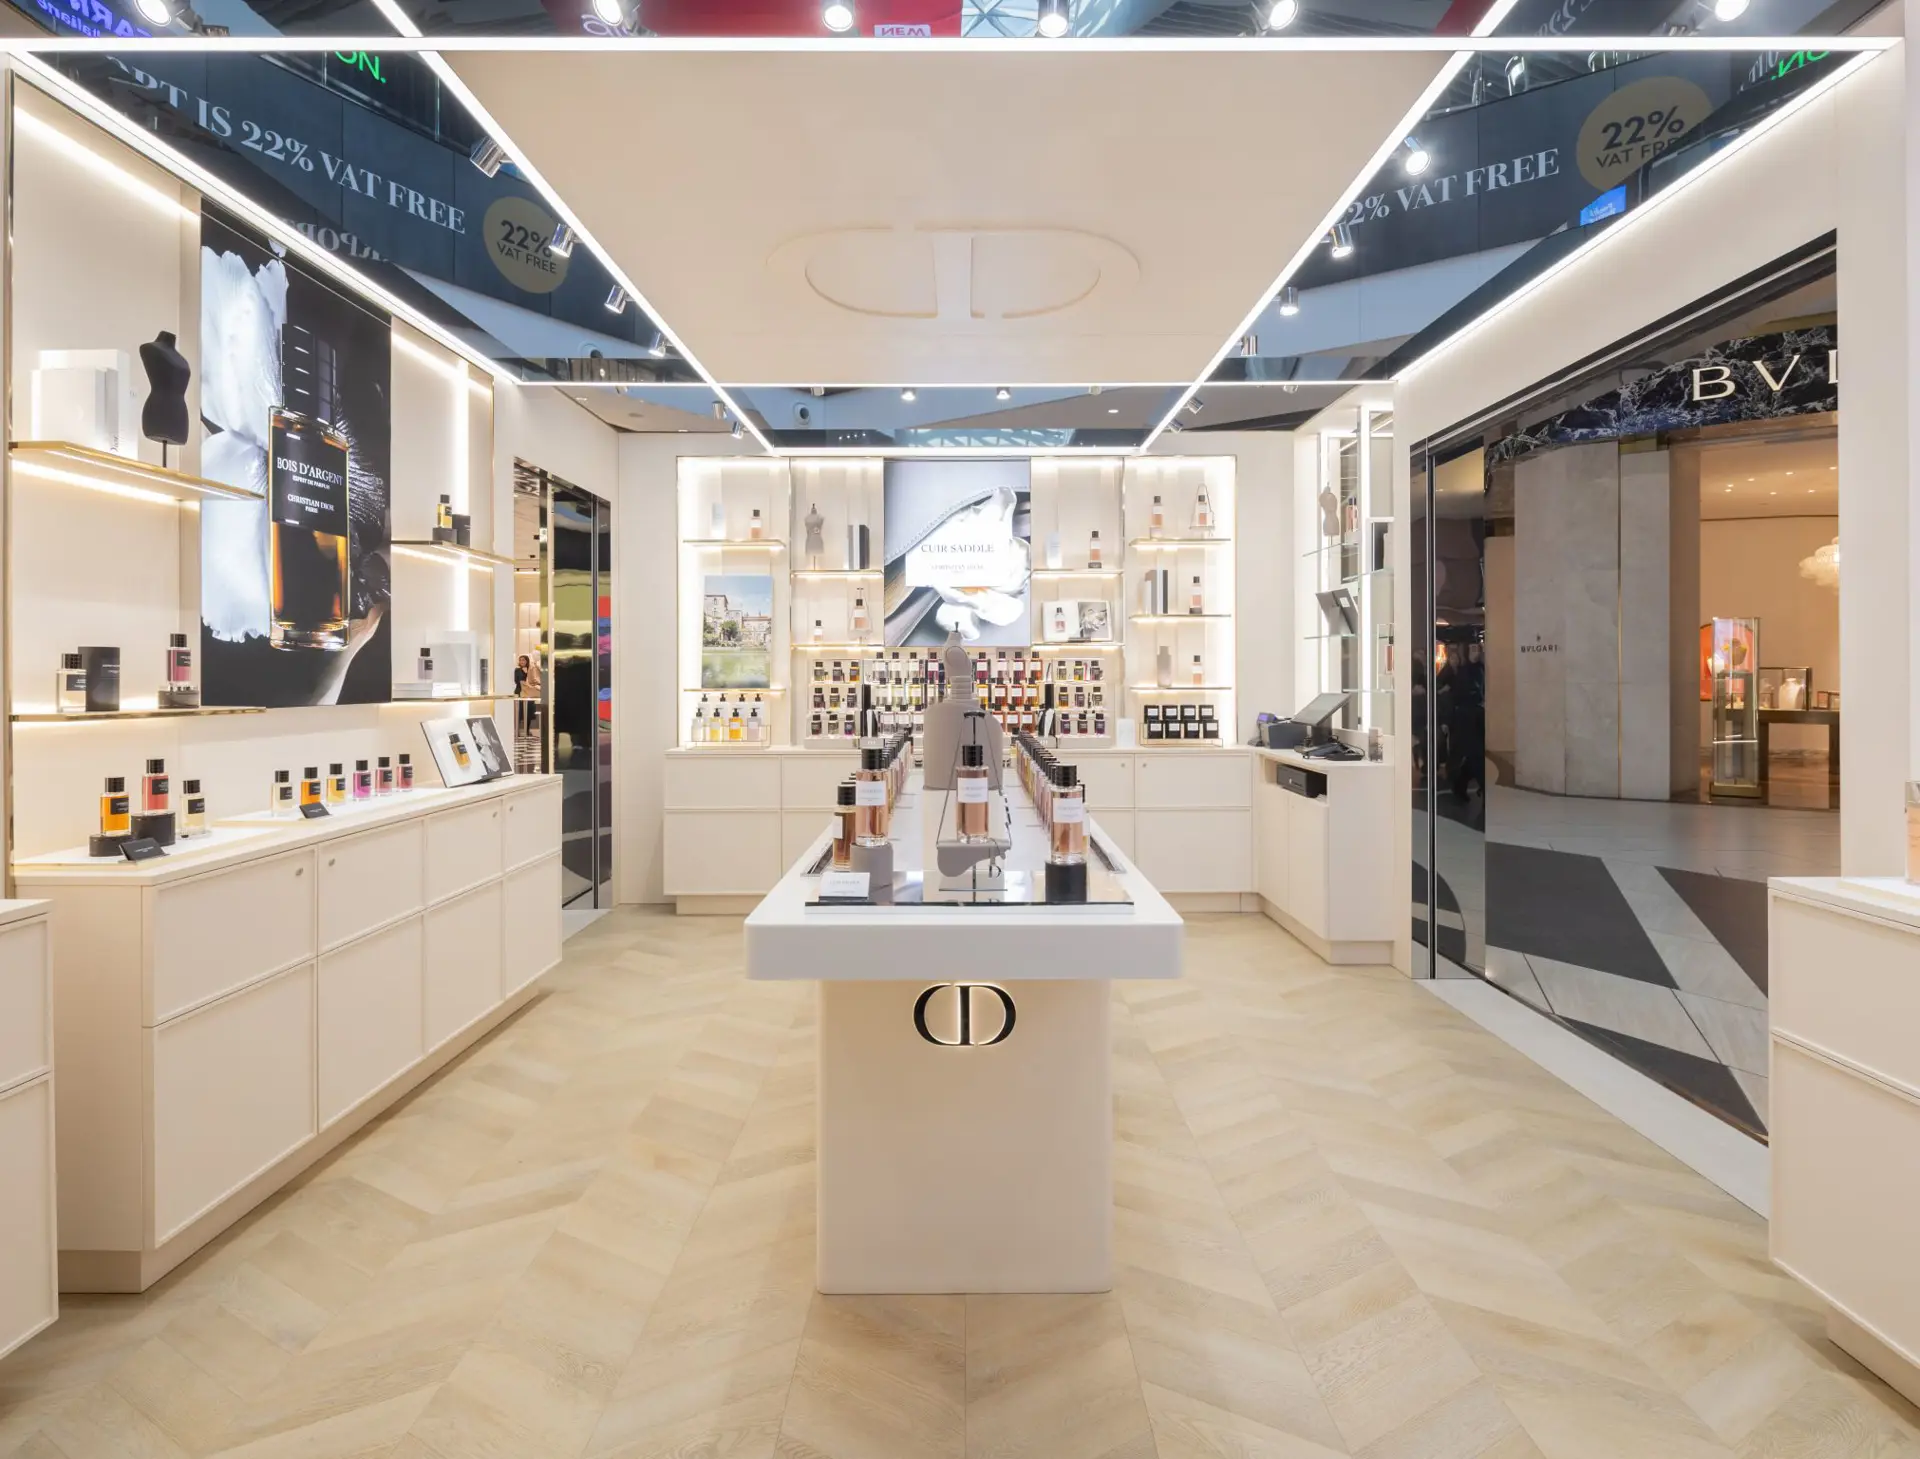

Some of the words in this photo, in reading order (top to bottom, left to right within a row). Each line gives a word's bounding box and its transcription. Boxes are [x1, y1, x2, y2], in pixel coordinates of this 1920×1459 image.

[1602, 105, 1685, 151] 22%
[196, 97, 232, 137] IS
[241, 120, 314, 172] 22%
[319, 150, 382, 199] VAT
[387, 180, 466, 234] FREE
[1595, 148, 1633, 168] VAT
[1396, 175, 1458, 212] VAT
[1464, 148, 1560, 197] FREE
[501, 220, 553, 258] 22%
[497, 241, 521, 261] VAT
[525, 253, 557, 275] FREE
[277, 457, 297, 473] BOIS
[299, 462, 344, 486] D'ARGENT
[287, 493, 320, 508] CHRISTIAN
[320, 502, 335, 512] DIOR
[921, 544, 947, 553] CUIR
[951, 544, 995, 553] SADDLE
